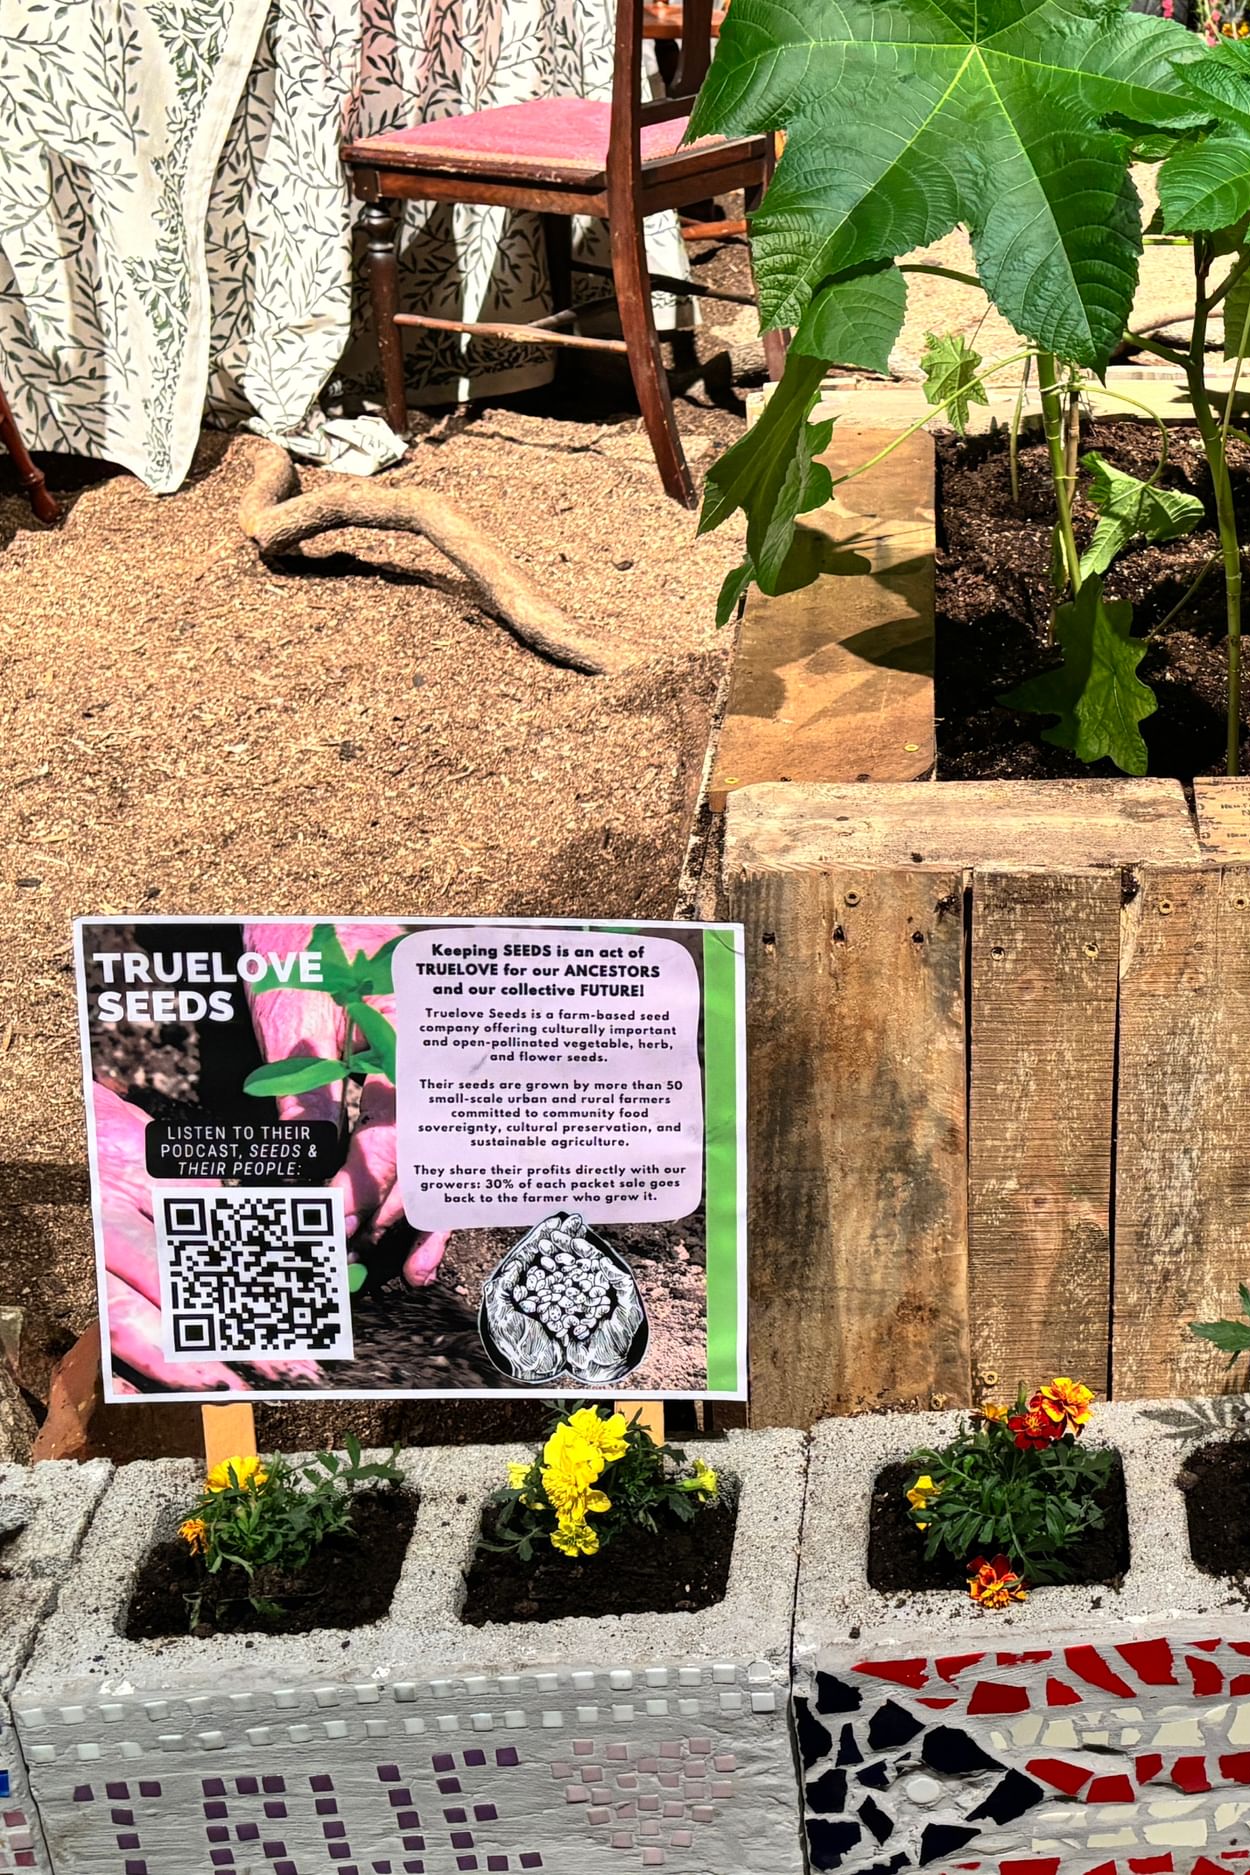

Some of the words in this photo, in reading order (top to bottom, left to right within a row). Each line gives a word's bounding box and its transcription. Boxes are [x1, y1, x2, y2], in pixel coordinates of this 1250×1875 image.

[432, 944, 498, 959] Keeping
[503, 944, 552, 957] SEEDS
[557, 945, 569, 957] is
[574, 949, 594, 958] an
[599, 947, 623, 958] act
[628, 946, 645, 958] of
[93, 952, 323, 983] TRUELOVE
[416, 963, 498, 976] TRUELOVE
[503, 963, 527, 976] for
[532, 968, 560, 976] our
[564, 964, 660, 978] ANCESTORS
[433, 982, 463, 995] and
[468, 986, 496, 995] our
[501, 982, 575, 996] collective
[580, 984, 644, 997] FUTURE!
[98, 990, 234, 1022] SEEDS
[425, 1008, 484, 1018] Truelove
[488, 1008, 526, 1019] Seeds
[531, 1009, 542, 1019] is
[558, 1008, 635, 1021] farm-based
[640, 1010, 670, 1021] seed
[419, 1025, 480, 1035] company
[484, 1022, 537, 1036] offering
[542, 1023, 605, 1037] culturally
[610, 1024, 676, 1037] important
[490, 1051, 514, 1061] and
[519, 1051, 562, 1062] flower
[567, 1052, 608, 1062] seeds.
[419, 1078, 454, 1089] Their
[458, 1079, 495, 1090] seeds
[499, 1082, 521, 1090] are
[526, 1082, 569, 1092] grown
[574, 1079, 590, 1092] by
[632, 1080, 662, 1090] than
[666, 1080, 683, 1090] 50
[429, 1093, 503, 1104] small-scale
[508, 1093, 547, 1104] urban
[552, 1093, 576, 1104] and
[581, 1093, 614, 1104] rural
[619, 1093, 671, 1104] farmers
[168, 1126, 225, 1140] LISTEN
[232, 1126, 254, 1140] TO
[260, 1126, 310, 1140] THEIR
[418, 1122, 502, 1135] sovereignty,
[506, 1122, 558, 1132] cultural
[562, 1122, 652, 1135] preservation,
[656, 1122, 681, 1132] and
[470, 1136, 546, 1146] sustainable
[551, 1136, 629, 1149] agriculture.
[161, 1144, 242, 1159] PODCAST,
[249, 1144, 301, 1158] SEEDS
[308, 1144, 317, 1158] &
[178, 1162, 226, 1175] THEIR
[232, 1162, 302, 1176] PEOPLE:
[444, 1192, 475, 1203] back
[480, 1194, 493, 1203] to
[497, 1192, 518, 1203] the
[522, 1192, 568, 1202] farmer
[572, 1192, 601, 1202] who
[605, 1194, 639, 1204] grew
[644, 1191, 657, 1201] it.
